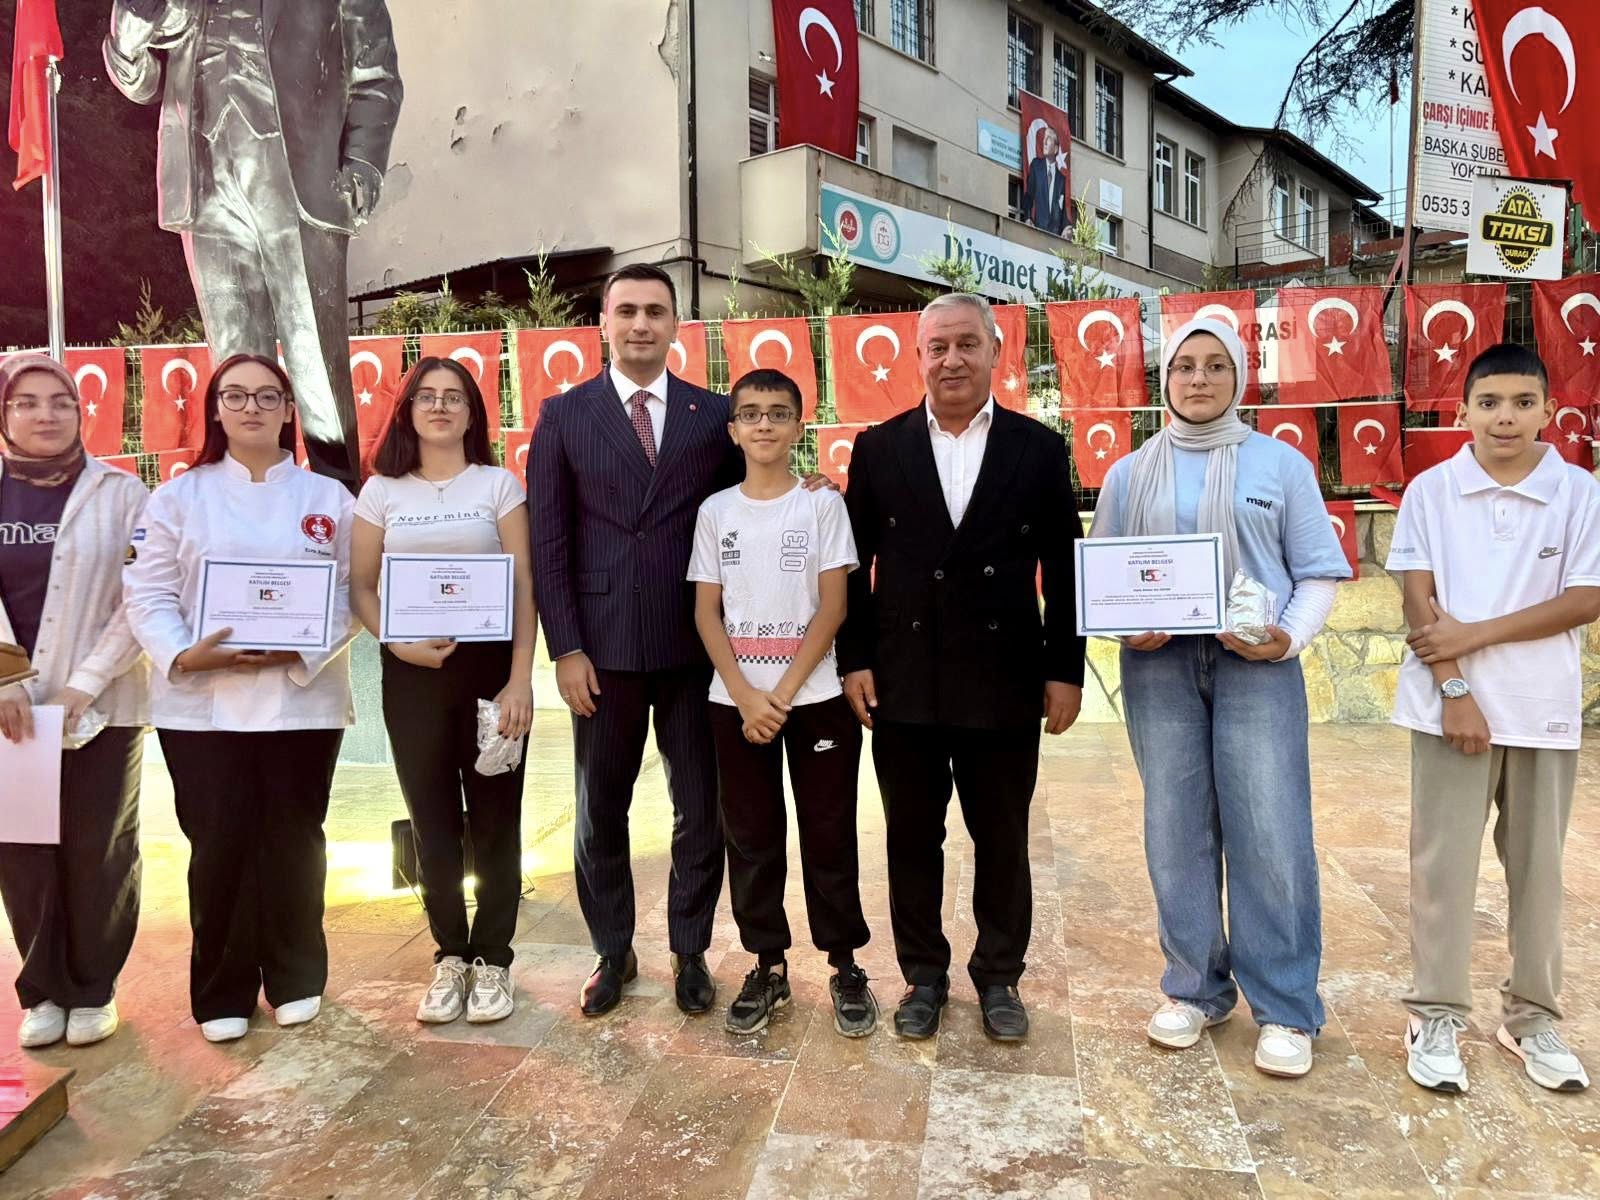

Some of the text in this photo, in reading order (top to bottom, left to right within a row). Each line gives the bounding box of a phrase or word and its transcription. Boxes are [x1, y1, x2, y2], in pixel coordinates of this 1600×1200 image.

[1460, 71, 1492, 98] KA
[1456, 103, 1489, 132] İÇİNDE
[1424, 136, 1508, 163] BAŞKA ŞUBE
[1422, 194, 1459, 215] 0535
[1507, 199, 1532, 217] ATA
[1488, 220, 1548, 243] TAKSİ
[943, 233, 1037, 293] Diyanet
[1246, 496, 1272, 510] mavi
[397, 510, 481, 522] Never mind
[737, 621, 754, 636] 100
[776, 620, 794, 637] 100
